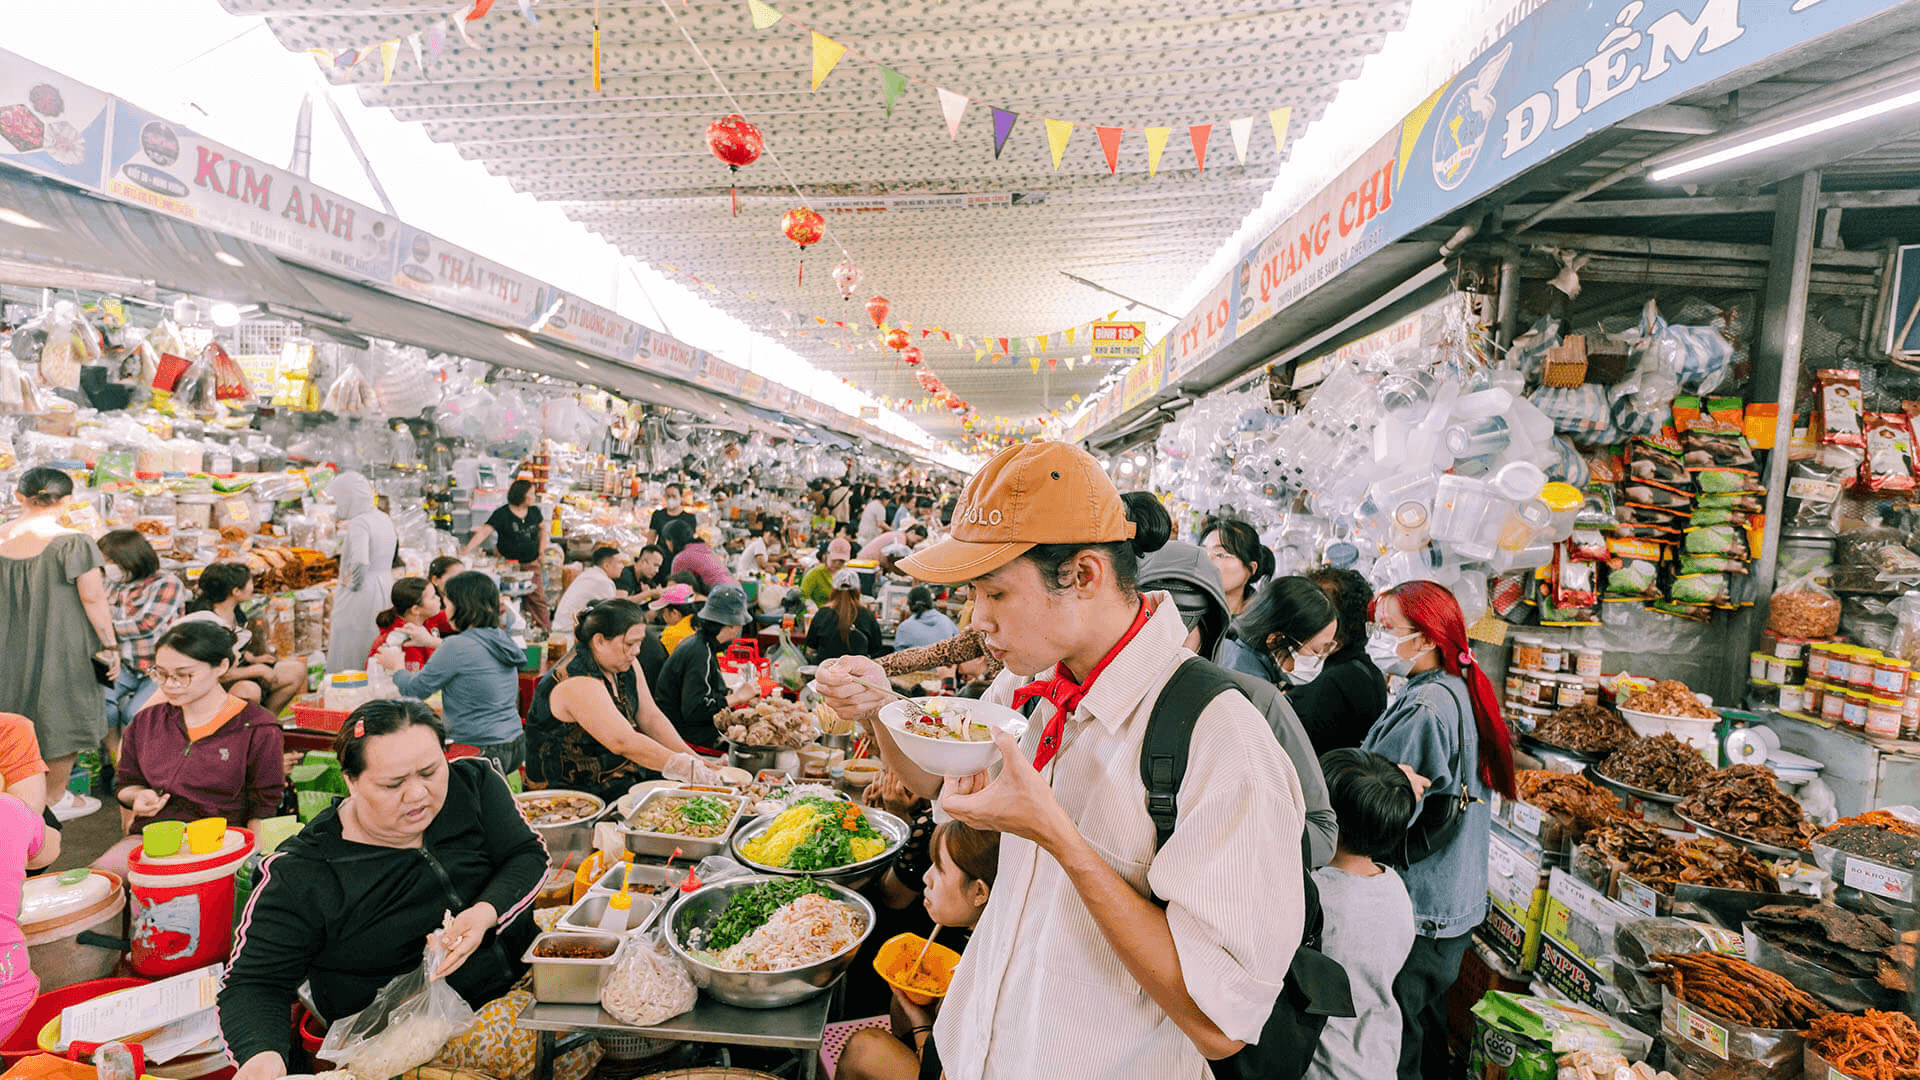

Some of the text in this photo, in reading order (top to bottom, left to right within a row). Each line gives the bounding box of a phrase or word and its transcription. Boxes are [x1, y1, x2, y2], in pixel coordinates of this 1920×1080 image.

[1502, 0, 1745, 159] ĐIỂM
[194, 145, 274, 211] KIM
[281, 184, 357, 241] ANH
[1260, 159, 1395, 303] QUANG CHI
[438, 251, 485, 290] THÁI
[1486, 1038, 1513, 1056] COCO
